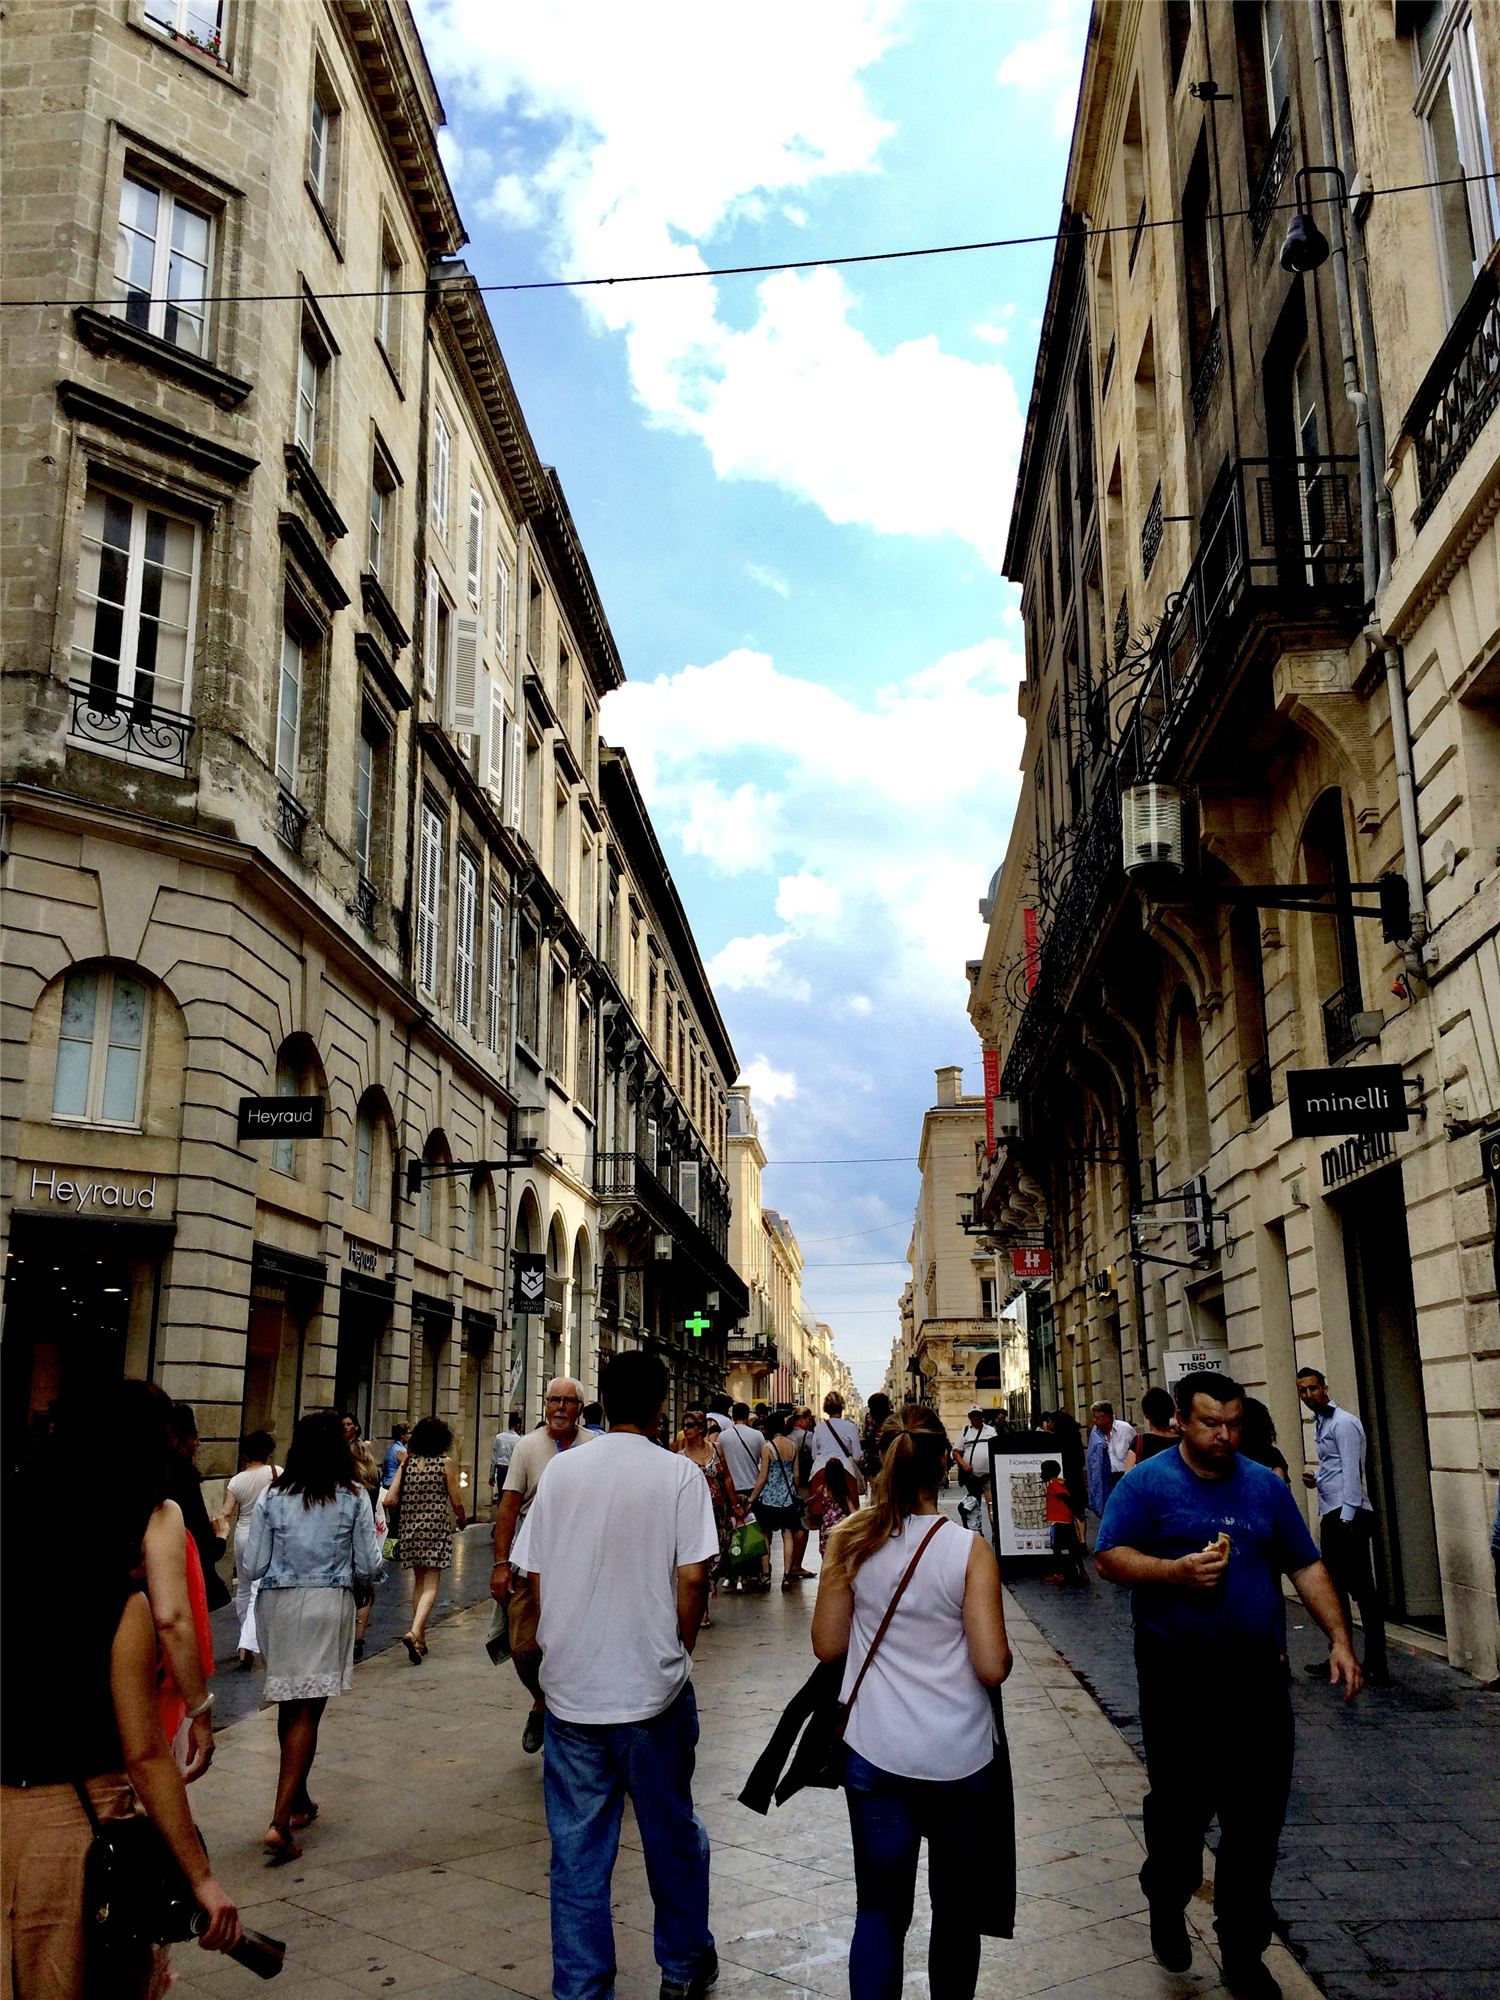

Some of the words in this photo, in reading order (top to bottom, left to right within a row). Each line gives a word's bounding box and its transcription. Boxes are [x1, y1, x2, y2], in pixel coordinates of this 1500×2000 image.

[1306, 1087, 1389, 1113] minelli
[247, 1107, 313, 1126] Heyraud
[30, 1168, 156, 1213] Heyraud
[1179, 1361, 1222, 1371] TISSOT
